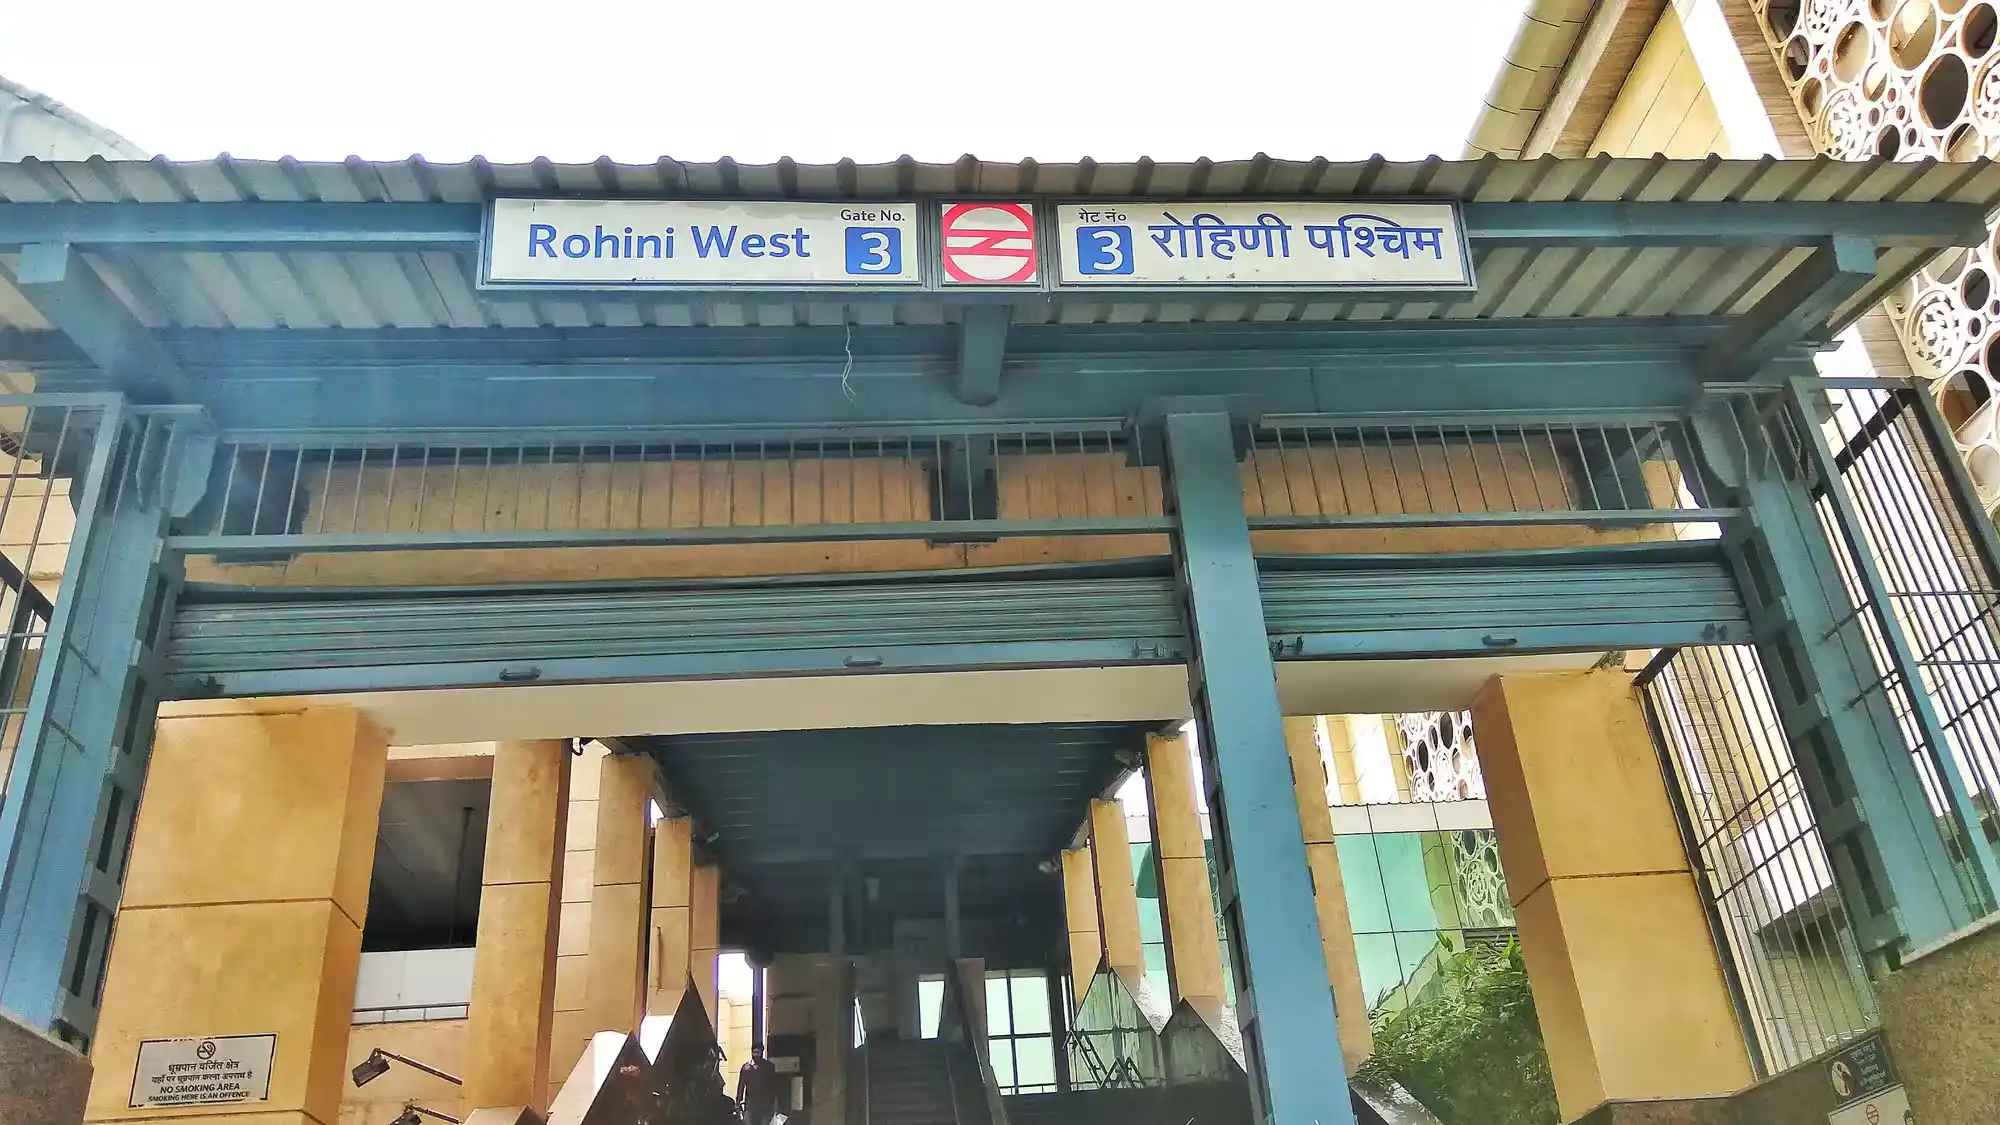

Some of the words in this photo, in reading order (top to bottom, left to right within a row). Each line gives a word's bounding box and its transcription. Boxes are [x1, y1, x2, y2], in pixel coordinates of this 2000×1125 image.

[840, 208, 876, 222] Gate
[880, 209, 905, 222] No.
[1078, 208, 1101, 224] गेट
[528, 223, 675, 259] Rohini
[690, 225, 811, 259] West
[1147, 212, 1292, 261] रोहिणी
[1303, 213, 1444, 261] पश्चिम
[859, 231, 892, 271] 3
[1092, 230, 1124, 271] 3
[168, 1063, 197, 1075] धूम्रपान
[199, 1060, 224, 1070] वर्जित
[175, 1084, 215, 1093] SMOKING
[216, 1082, 240, 1091] AREA
[181, 1093, 199, 1101] HERE
[218, 1090, 250, 1099] OFFENCE
